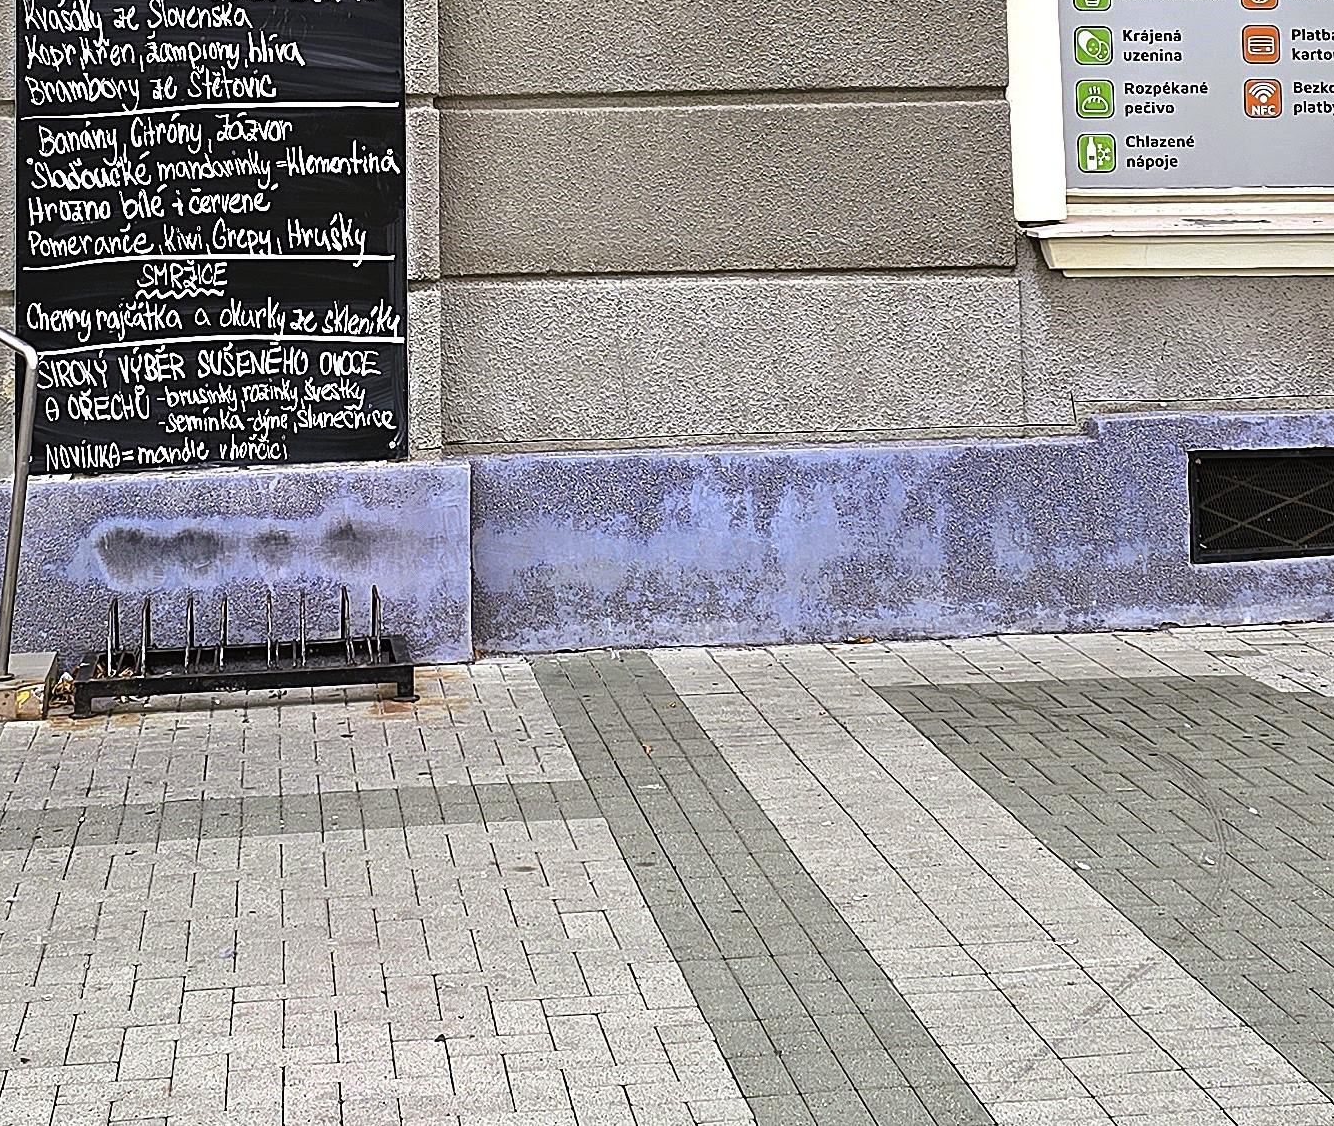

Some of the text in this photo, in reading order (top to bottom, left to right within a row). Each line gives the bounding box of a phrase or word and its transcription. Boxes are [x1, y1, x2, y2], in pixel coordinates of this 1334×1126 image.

[113, 6, 140, 30] ze
[1122, 29, 1182, 46] Krájená
[1123, 49, 1183, 62] uzenina
[25, 73, 140, 112] Brambory
[150, 76, 178, 100] ze
[1124, 82, 1209, 98] Rozpékané
[1125, 102, 1175, 117] pečivo
[1251, 105, 1276, 116] NFC
[1125, 135, 1195, 149] Chlazené
[157, 148, 271, 190] mandarinky
[1126, 155, 1179, 170] nápoje
[28, 197, 111, 226] Hrozno
[137, 260, 228, 289] SMRŽICE
[27, 303, 91, 342] Cherry
[96, 300, 183, 341] rajčátka
[194, 308, 211, 326] a
[220, 297, 286, 340] okurky
[289, 309, 317, 332] ze
[118, 347, 185, 383] VÝBĚR
[198, 342, 308, 378] SUŠENÉHO
[320, 350, 381, 376] OVOCE
[68, 385, 150, 420] OŘECHŮ
